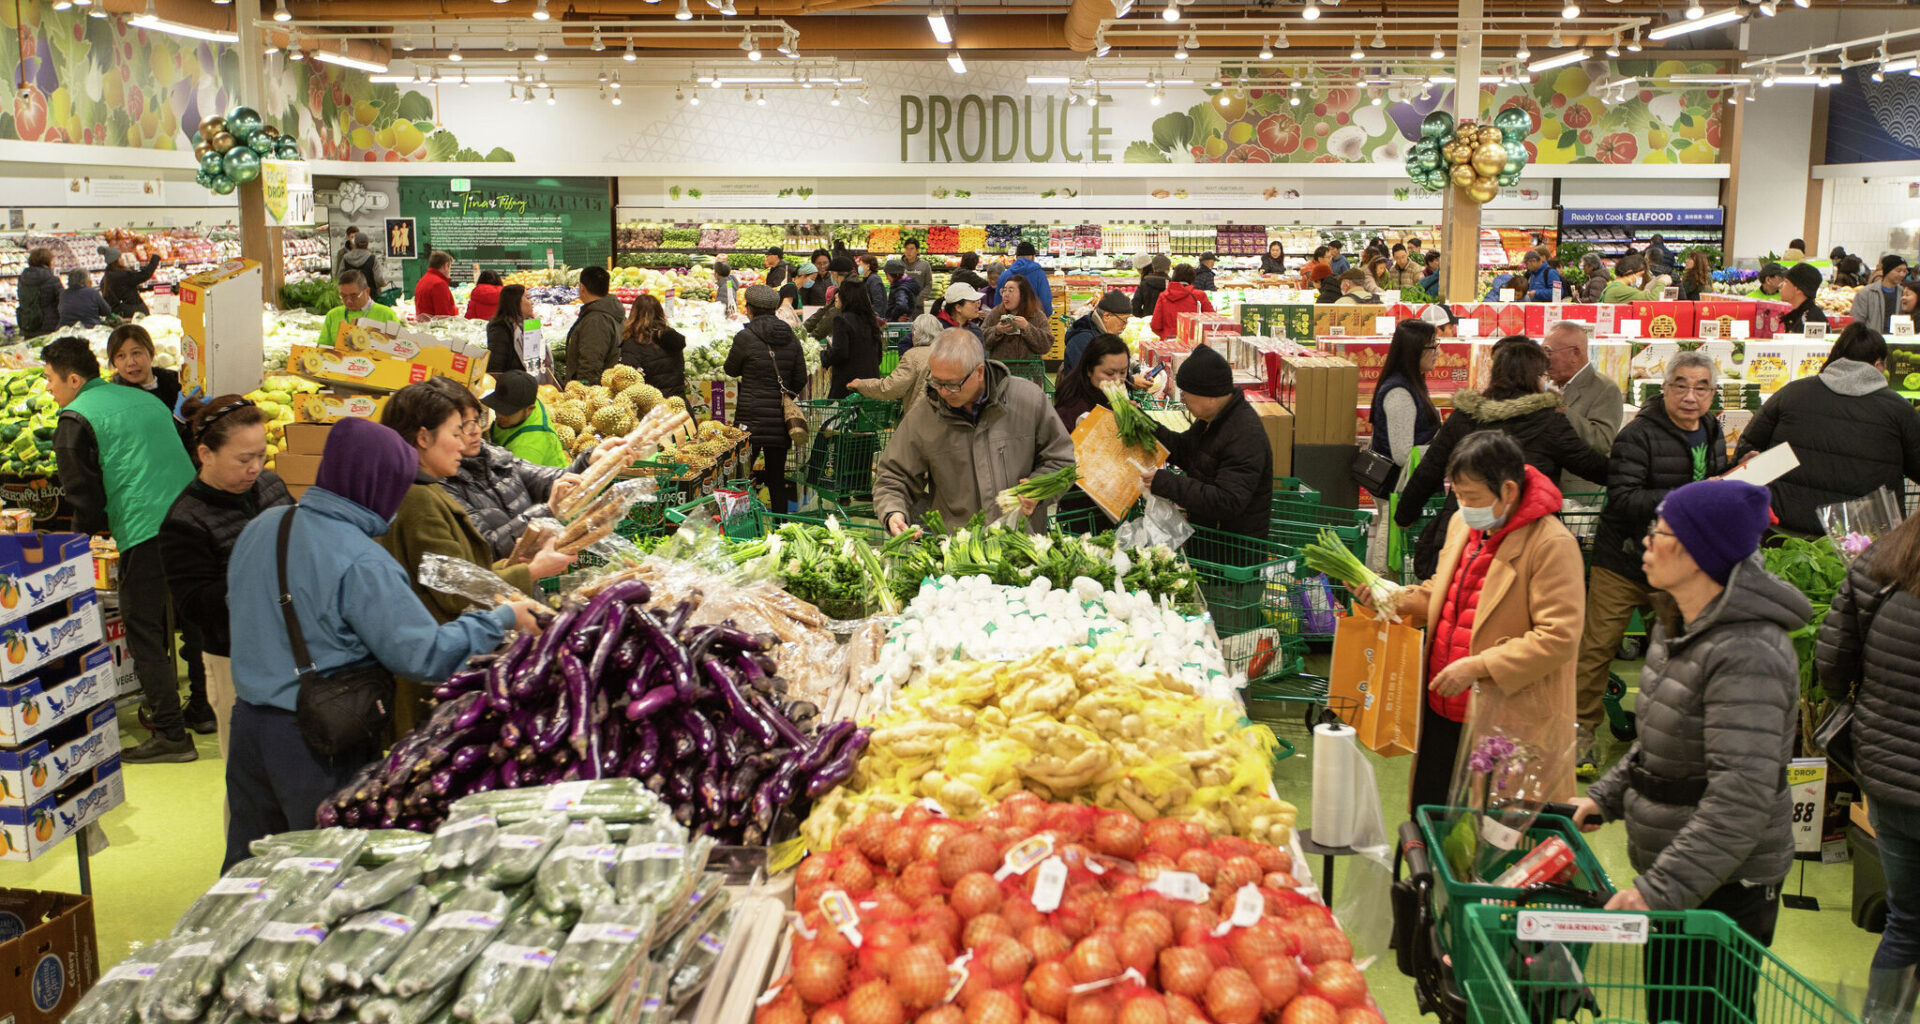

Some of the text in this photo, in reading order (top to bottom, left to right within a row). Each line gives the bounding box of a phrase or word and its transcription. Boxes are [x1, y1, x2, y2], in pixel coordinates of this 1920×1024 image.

[900, 94, 1113, 163] PRODUCE
[267, 185, 285, 199] DROP
[460, 190, 489, 215] Tina
[496, 194, 527, 215] Tiffany
[1571, 213, 1673, 222] Ready to Cook SEAFOOD
[1358, 369, 1380, 379] ARO
[1792, 802, 1815, 823] 88
